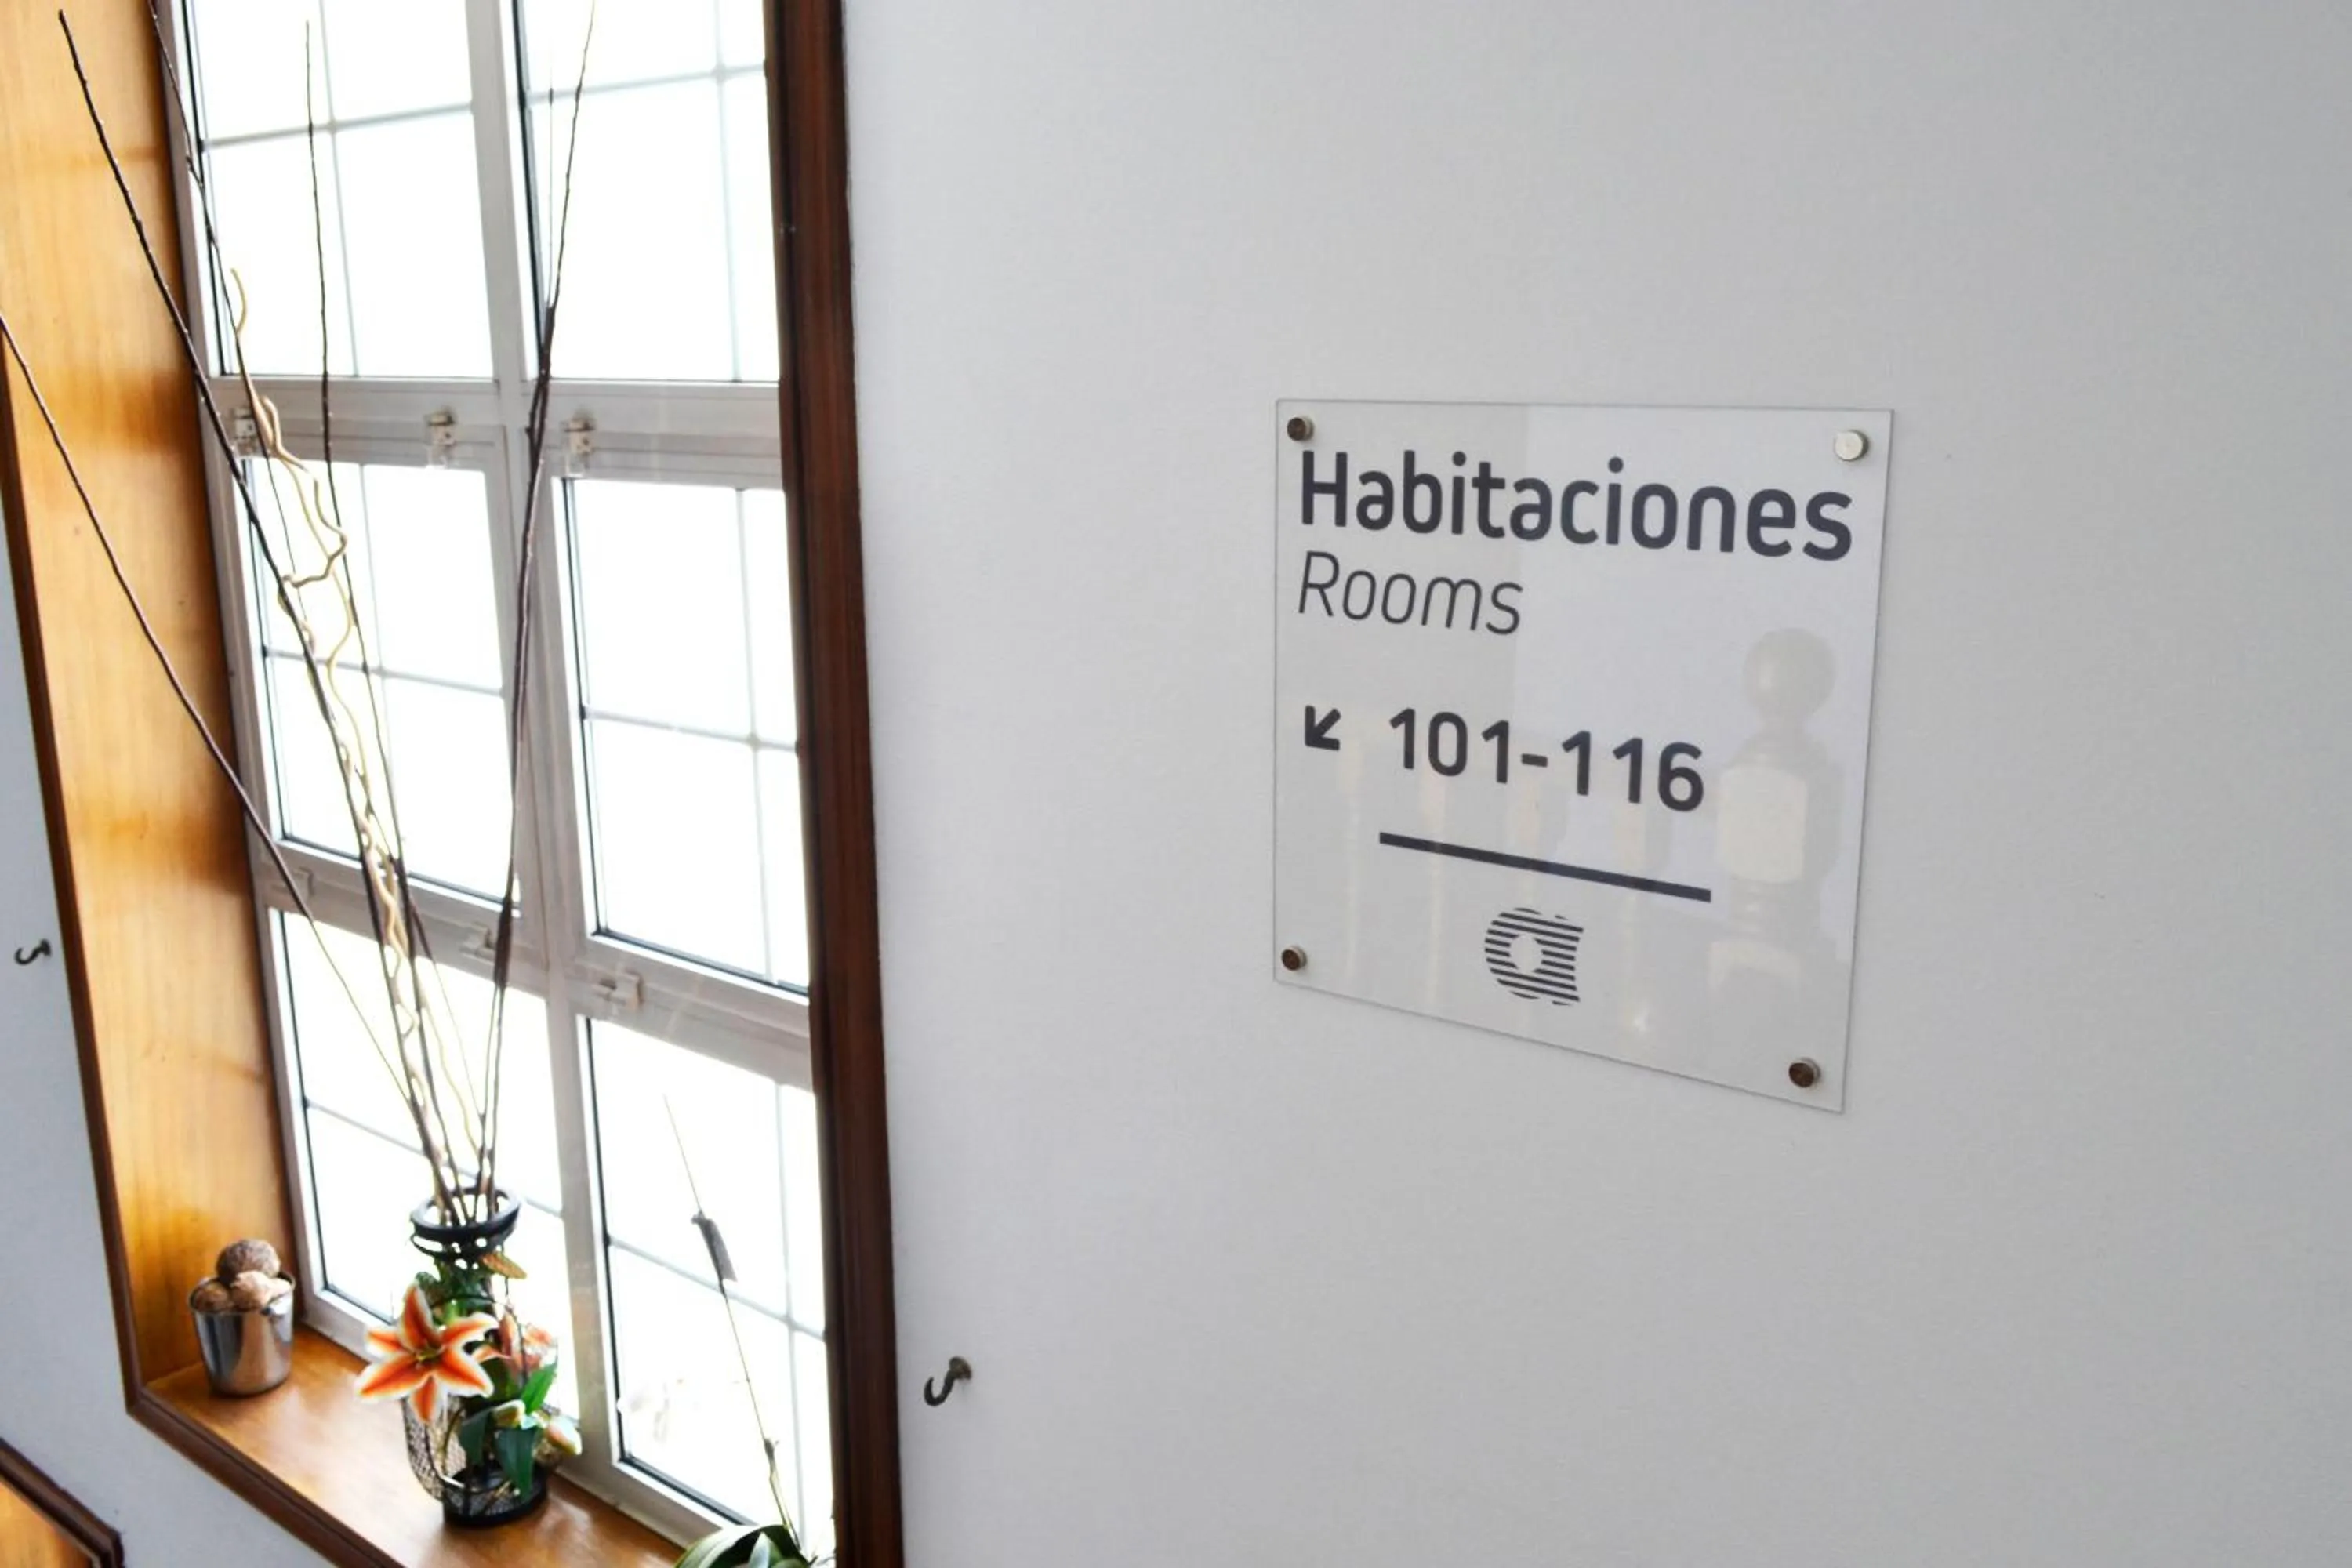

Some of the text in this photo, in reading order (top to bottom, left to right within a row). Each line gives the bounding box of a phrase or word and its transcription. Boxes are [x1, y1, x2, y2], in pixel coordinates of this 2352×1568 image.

[1301, 449, 1853, 561] Habitaciones
[1298, 550, 1524, 636] Rooms
[1388, 707, 1705, 814] 101-116
